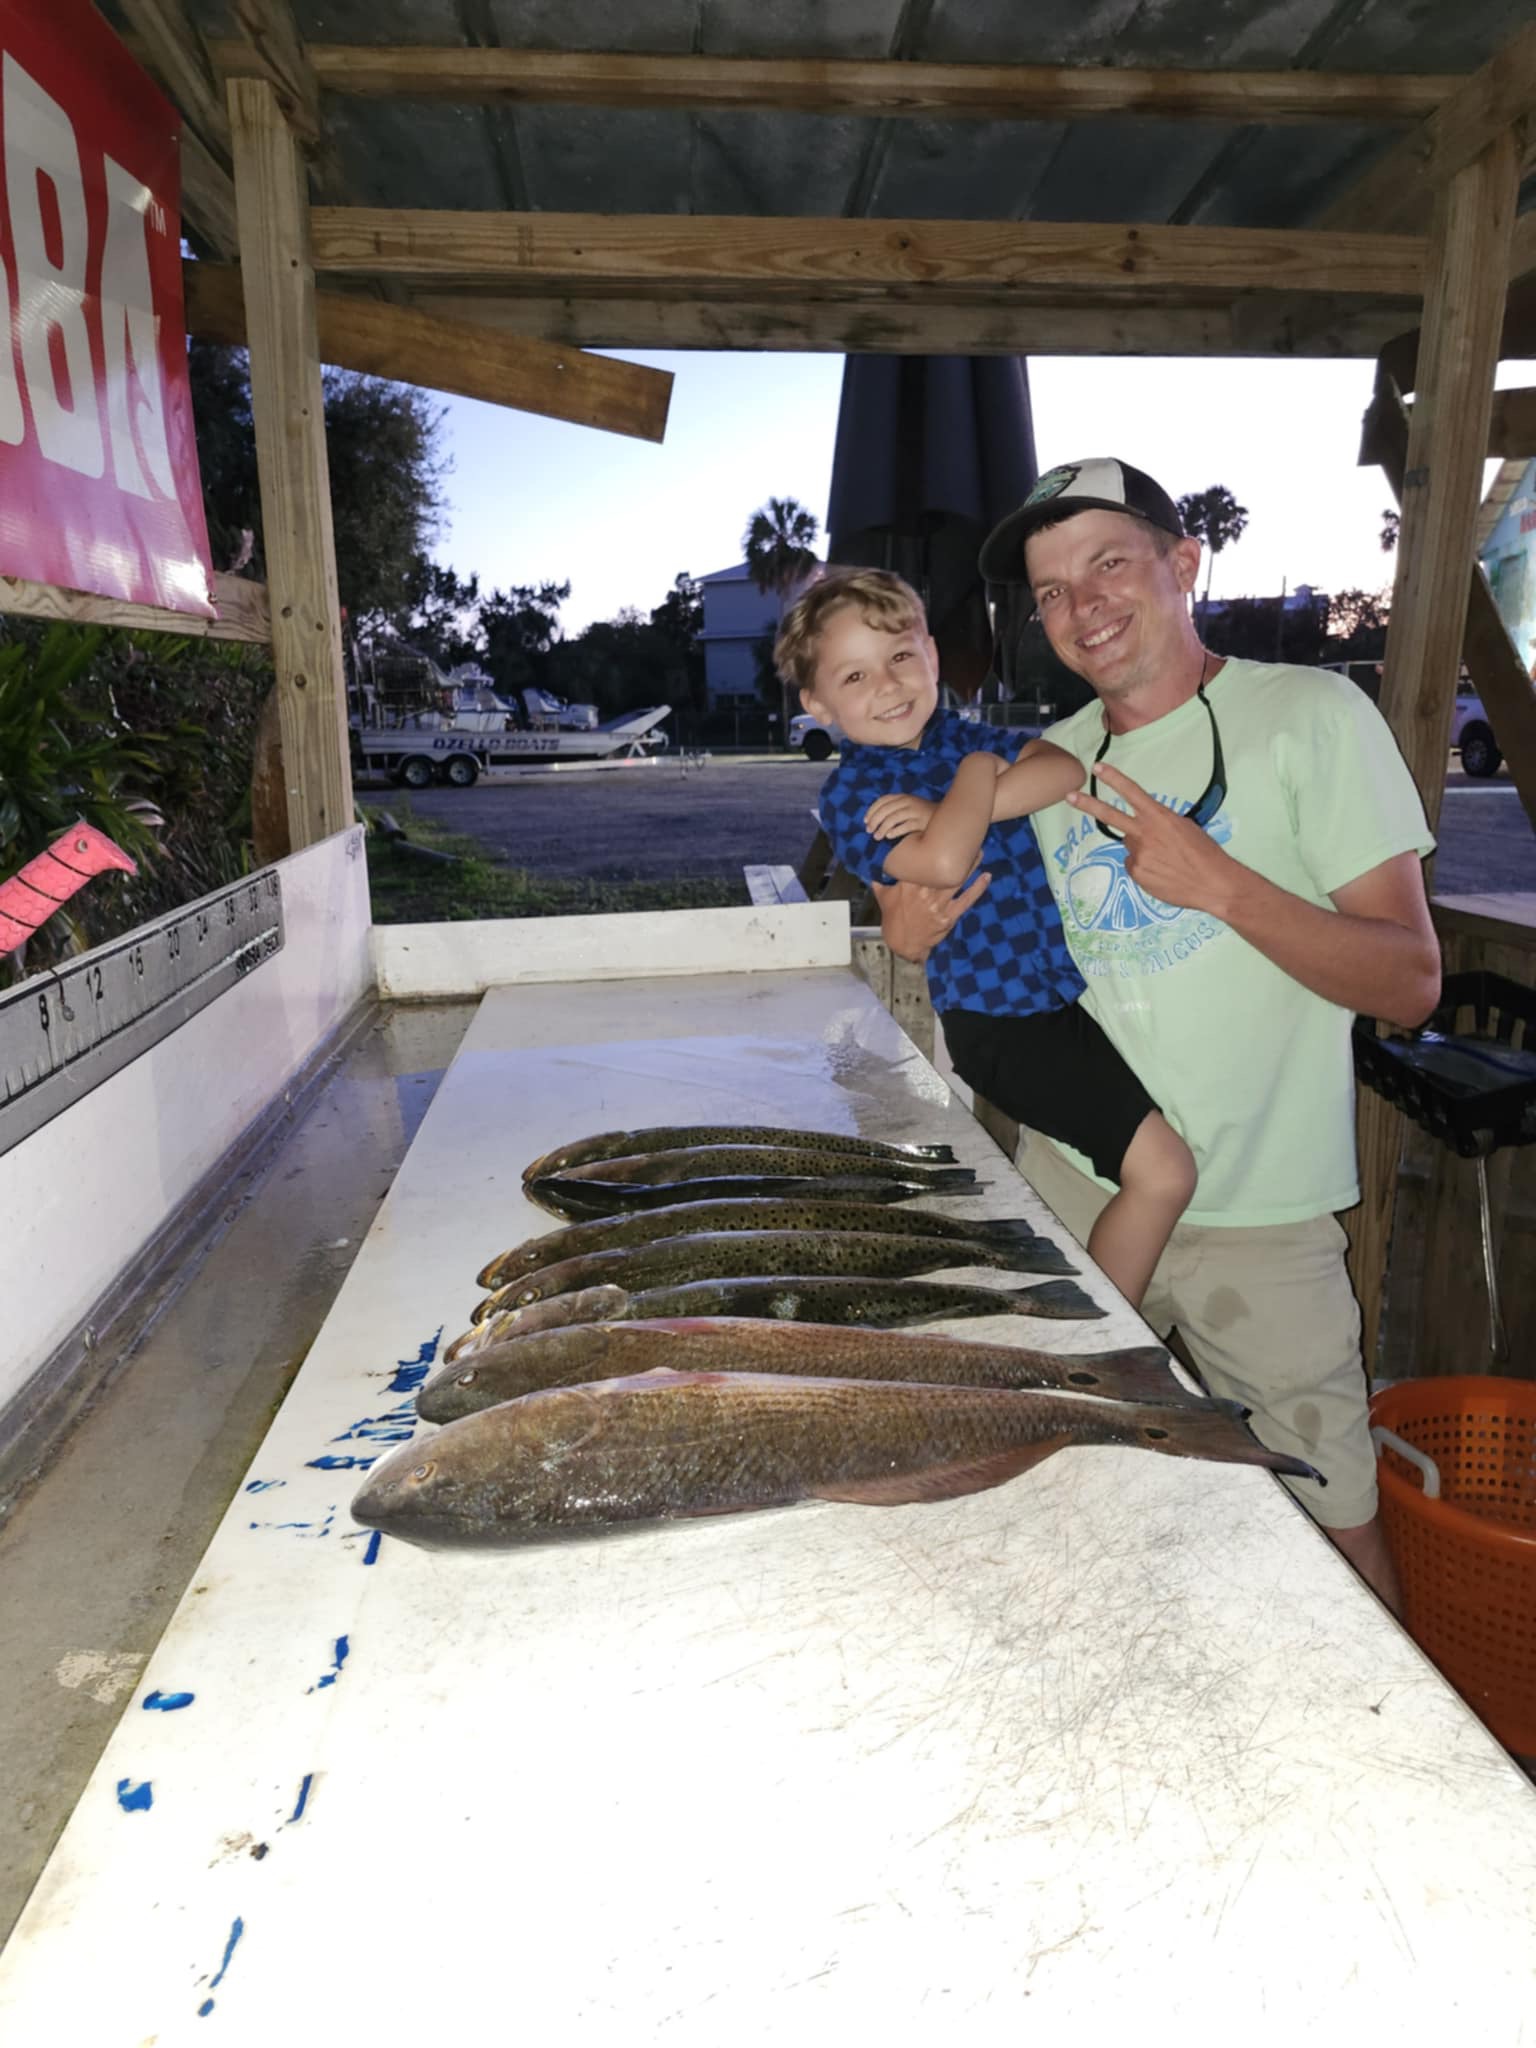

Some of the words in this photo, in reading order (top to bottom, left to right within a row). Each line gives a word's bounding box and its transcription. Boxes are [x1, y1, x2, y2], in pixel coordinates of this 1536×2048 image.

[0, 48, 178, 500] BA
[433, 737, 501, 750] OZELLO
[39, 994, 50, 1031] 8
[86, 966, 104, 1001] 12
